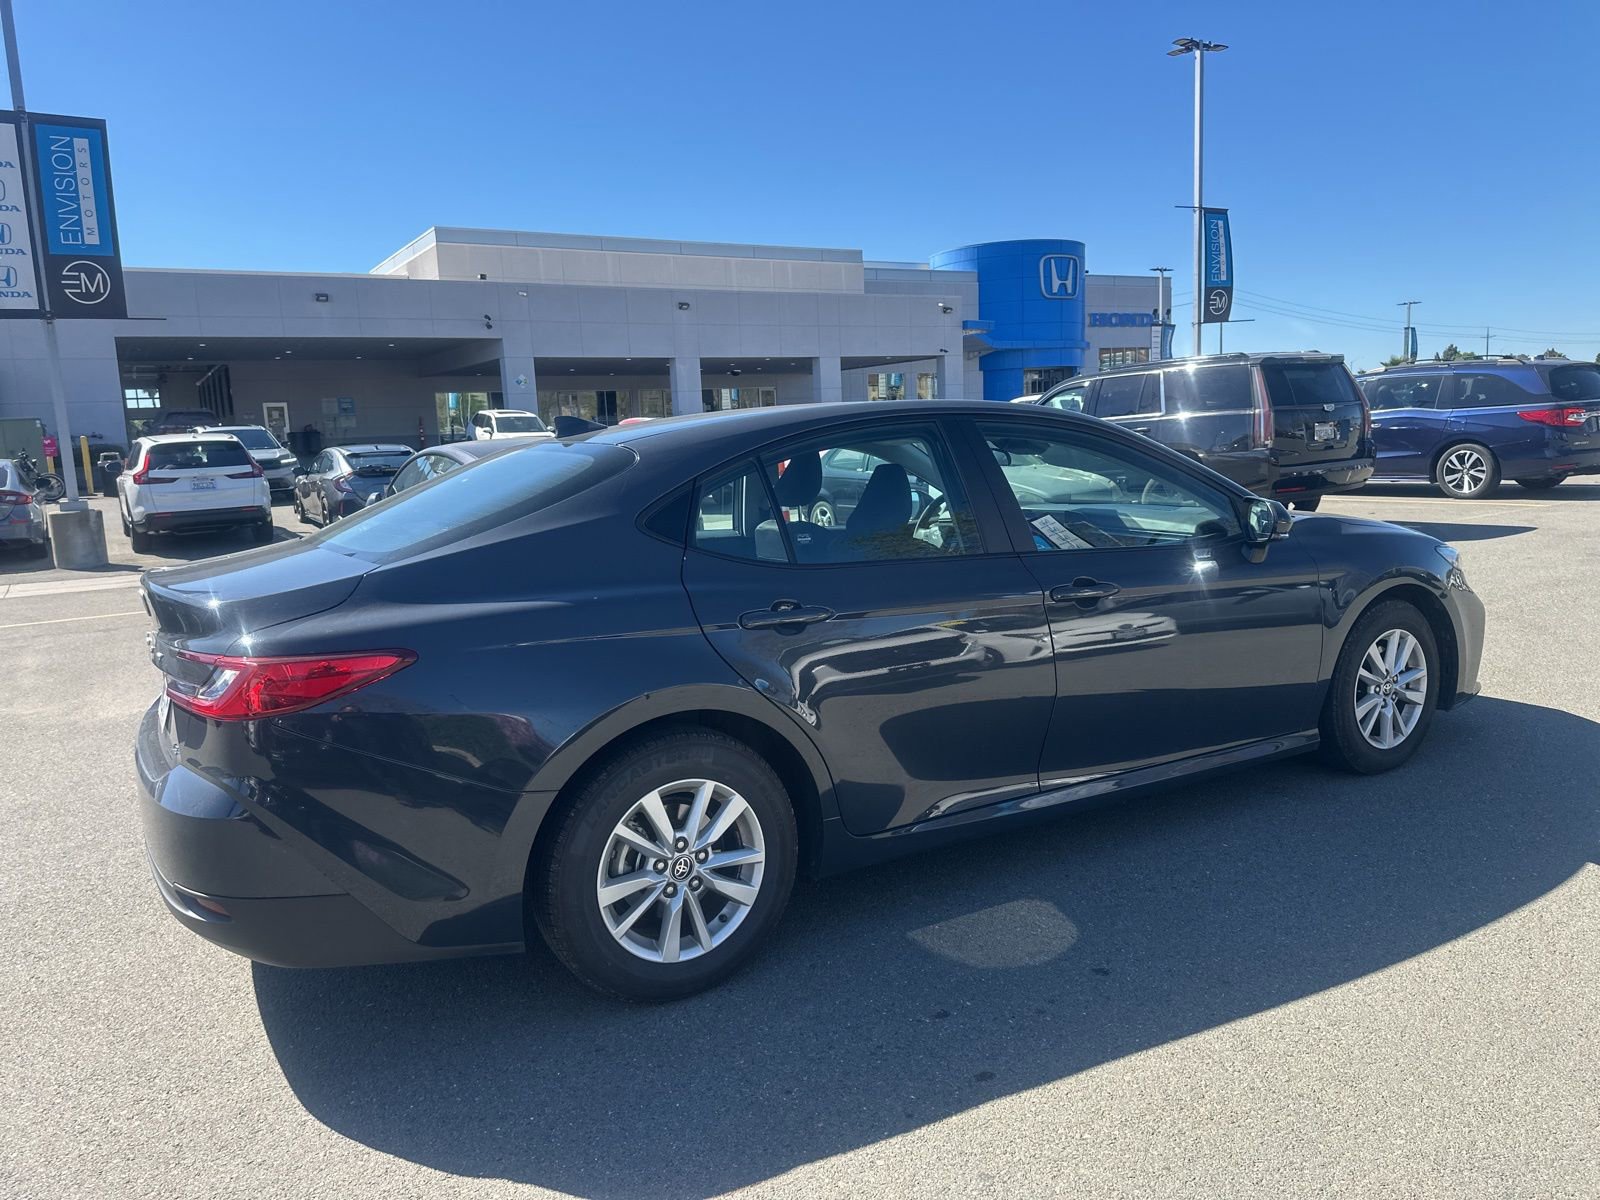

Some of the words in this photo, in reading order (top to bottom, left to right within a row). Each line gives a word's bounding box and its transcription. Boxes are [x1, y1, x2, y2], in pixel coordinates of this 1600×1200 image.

[49, 135, 82, 245] ENVISION
[78, 146, 96, 236] MOTORS
[1209, 219, 1221, 282] ENVISION
[1088, 313, 1153, 327] HOND
